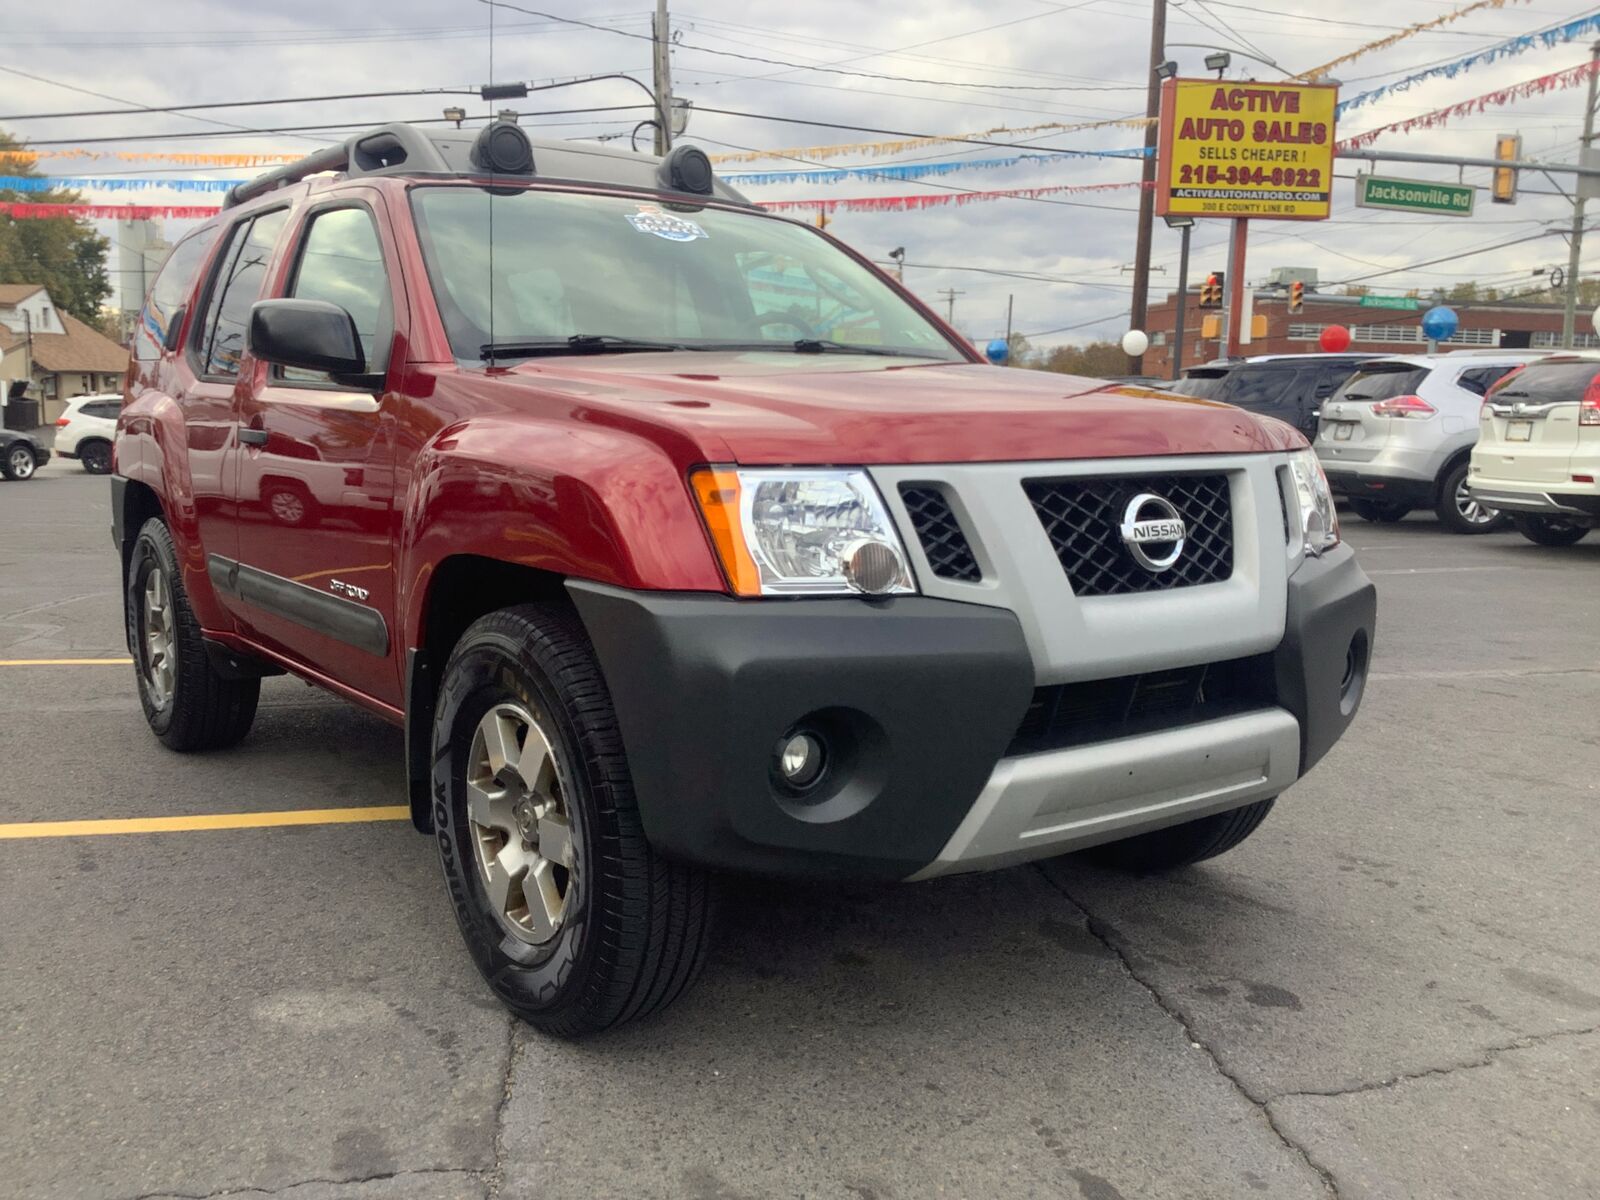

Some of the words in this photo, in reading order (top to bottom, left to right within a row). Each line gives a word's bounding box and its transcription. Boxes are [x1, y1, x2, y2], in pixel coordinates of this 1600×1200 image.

[1210, 88, 1301, 113] ACTIVE
[1178, 118, 1245, 142] AUTO
[1252, 120, 1327, 144] SALES
[1199, 146, 1237, 160] SELLS
[1241, 148, 1299, 162] CHEAPER
[1176, 188, 1321, 201] ACTIVEAUTOHATBORO.COM
[1368, 185, 1450, 205] Jacksonville
[1452, 192, 1470, 207] Rd
[1226, 203, 1261, 213] COUNTY
[1263, 204, 1281, 213] LINE
[1284, 205, 1296, 213] RD
[1133, 524, 1184, 539] NISSAN
